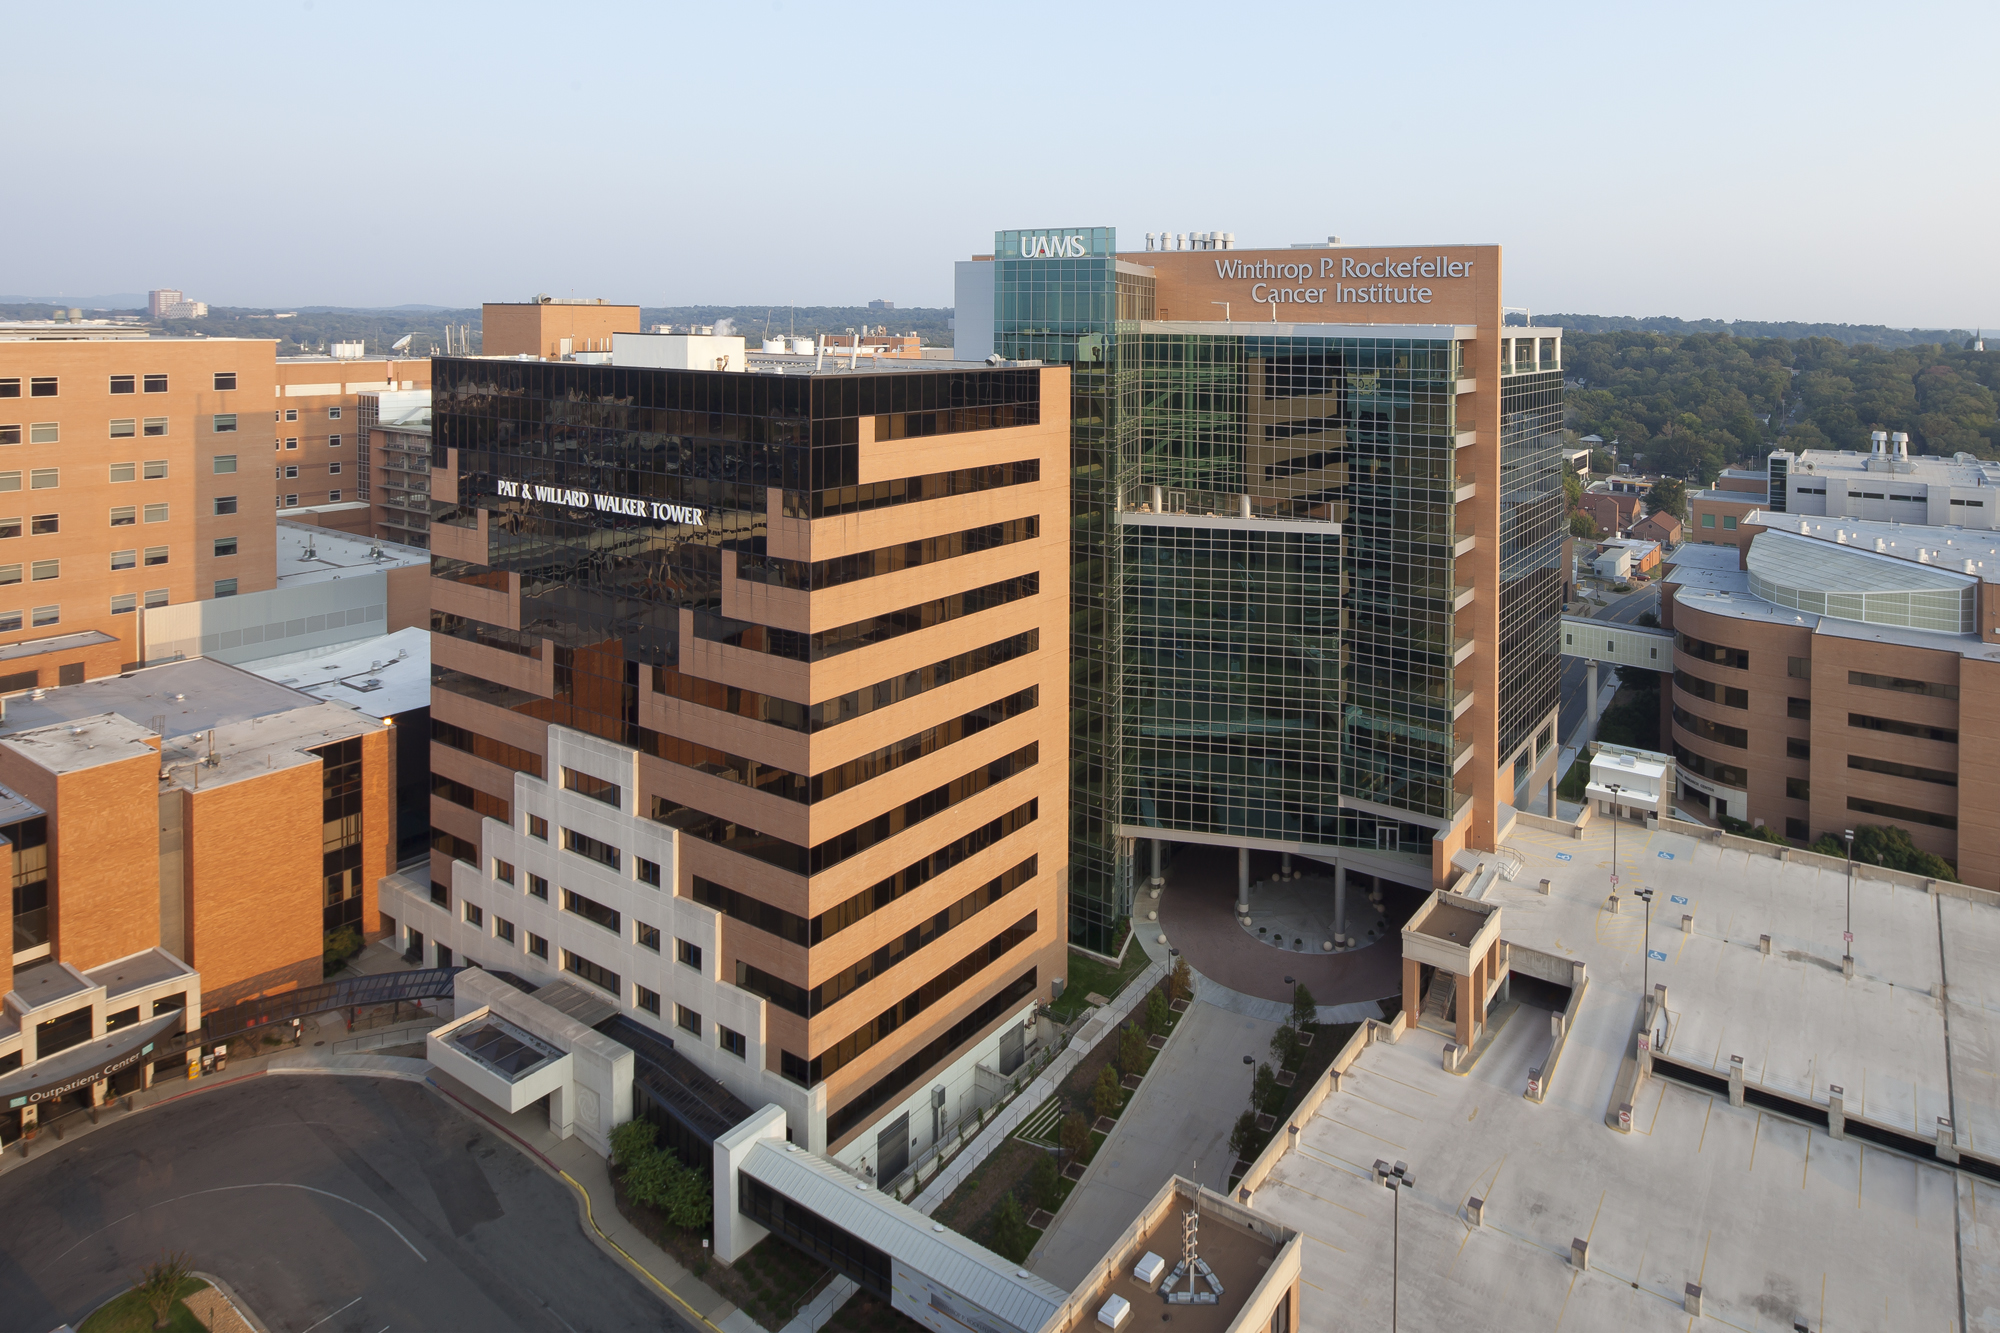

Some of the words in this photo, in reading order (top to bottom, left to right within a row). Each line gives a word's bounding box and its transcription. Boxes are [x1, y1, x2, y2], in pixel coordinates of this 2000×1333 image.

[1021, 235, 1085, 258] UAMS
[1215, 259, 1313, 284] Winthrop
[1320, 257, 1334, 278] P.
[1341, 256, 1474, 278] Rockefeller
[1251, 283, 1327, 304] Cancer
[1336, 282, 1433, 304] Institute
[497, 480, 519, 498] PAT
[521, 483, 533, 500] &
[534, 485, 589, 508] WILLARD
[594, 493, 647, 518] WALKER
[650, 502, 704, 526] TOWER
[28, 1072, 100, 1103] Outpatient
[103, 1052, 140, 1075] Center
